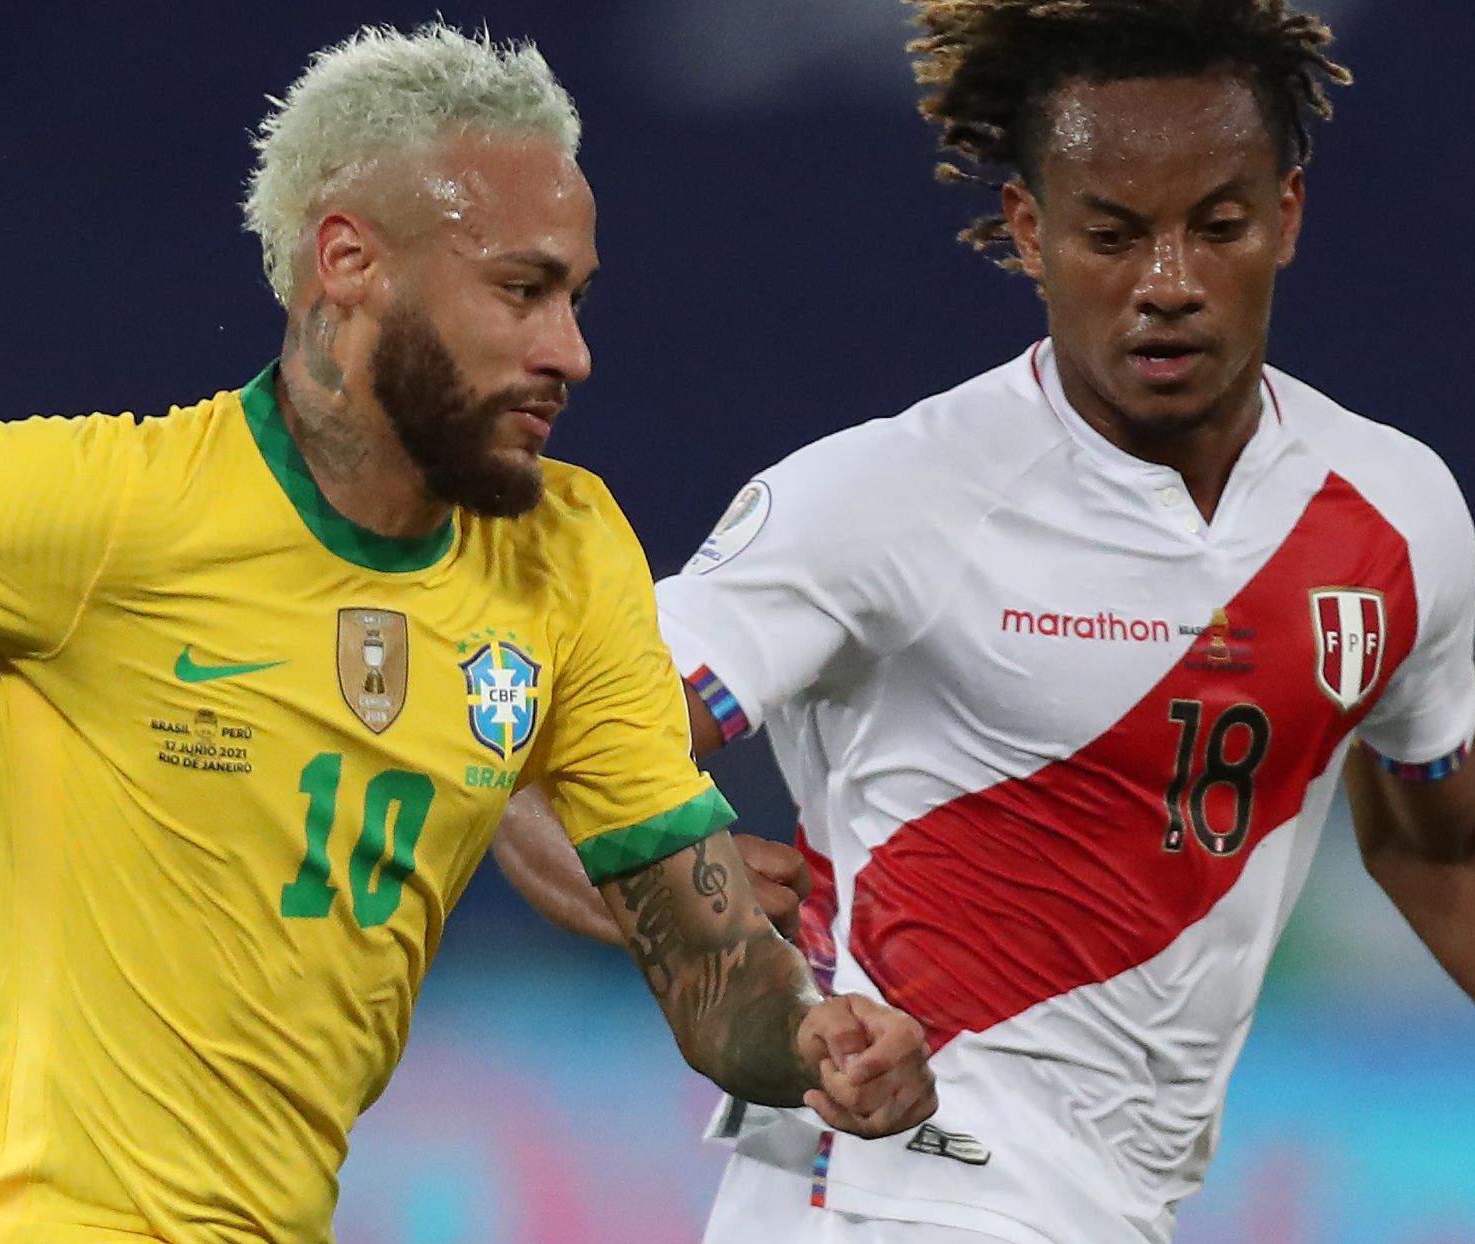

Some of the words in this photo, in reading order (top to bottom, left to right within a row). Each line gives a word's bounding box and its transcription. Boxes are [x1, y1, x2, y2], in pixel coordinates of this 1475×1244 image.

[1002, 608, 1169, 642] marathon
[489, 689, 518, 703] CBF
[150, 719, 190, 734] BRASIL
[158, 751, 180, 765] RIO
[184, 757, 199, 769] DE
[202, 760, 253, 774] JANEIRO
[179, 743, 217, 756] JUNIO
[220, 746, 247, 759] 2021
[1162, 698, 1272, 857] 18
[280, 752, 436, 928] 10
